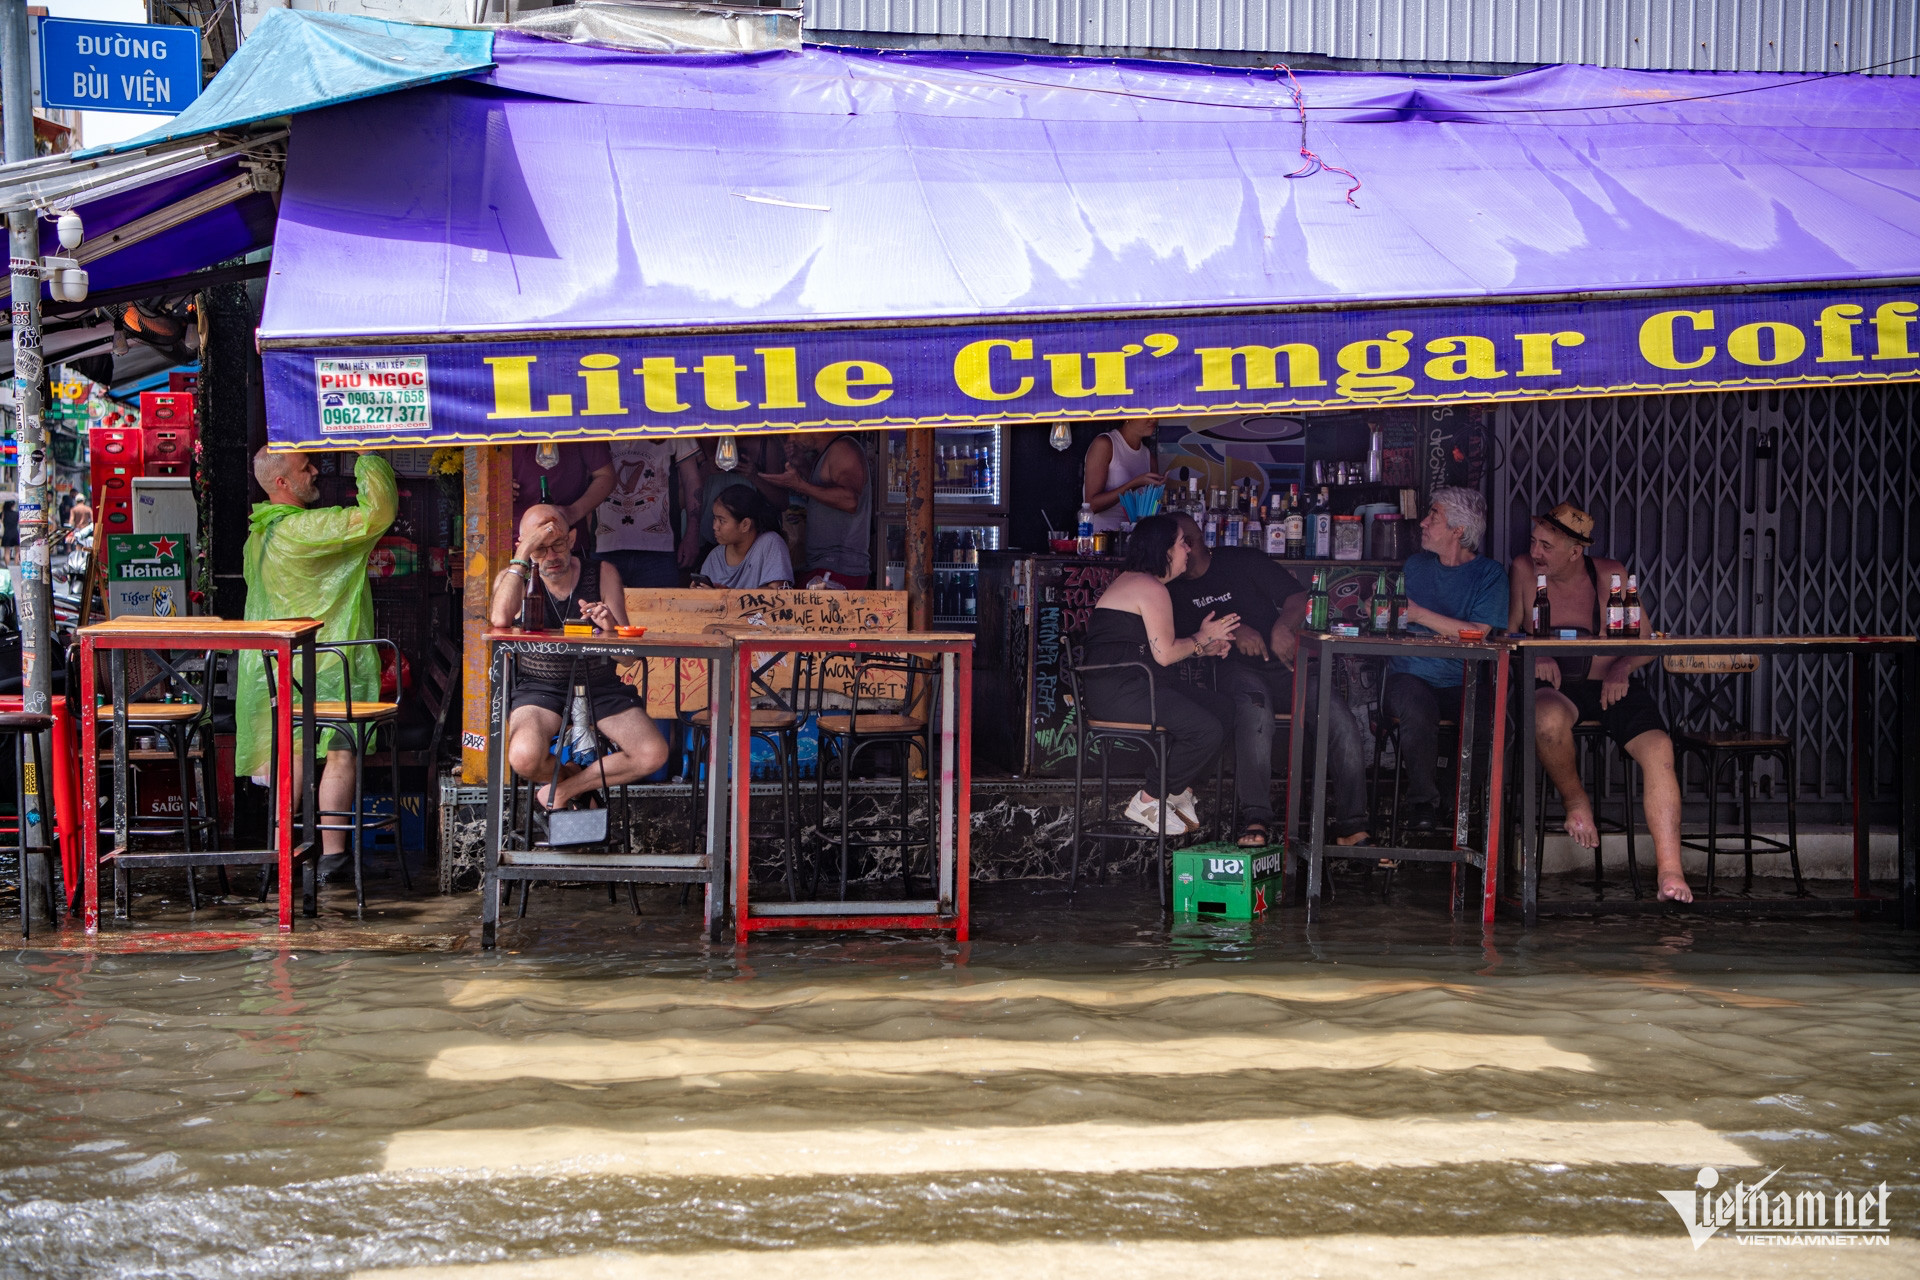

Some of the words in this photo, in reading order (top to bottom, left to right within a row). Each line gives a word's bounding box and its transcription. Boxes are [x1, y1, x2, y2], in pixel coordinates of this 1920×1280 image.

[76, 32, 168, 60] ĐƯỜNG
[73, 64, 109, 100] BÙI
[120, 68, 171, 108] VIỆN
[320, 371, 362, 389] PHÚ
[368, 371, 424, 390] NGỌC
[483, 346, 894, 420] Little
[347, 389, 425, 406] 0903.78.7658
[323, 405, 426, 426] 0962.227.377
[120, 591, 151, 606] Tiger
[151, 801, 198, 813] SAIGN
[167, 795, 183, 803] BIA
